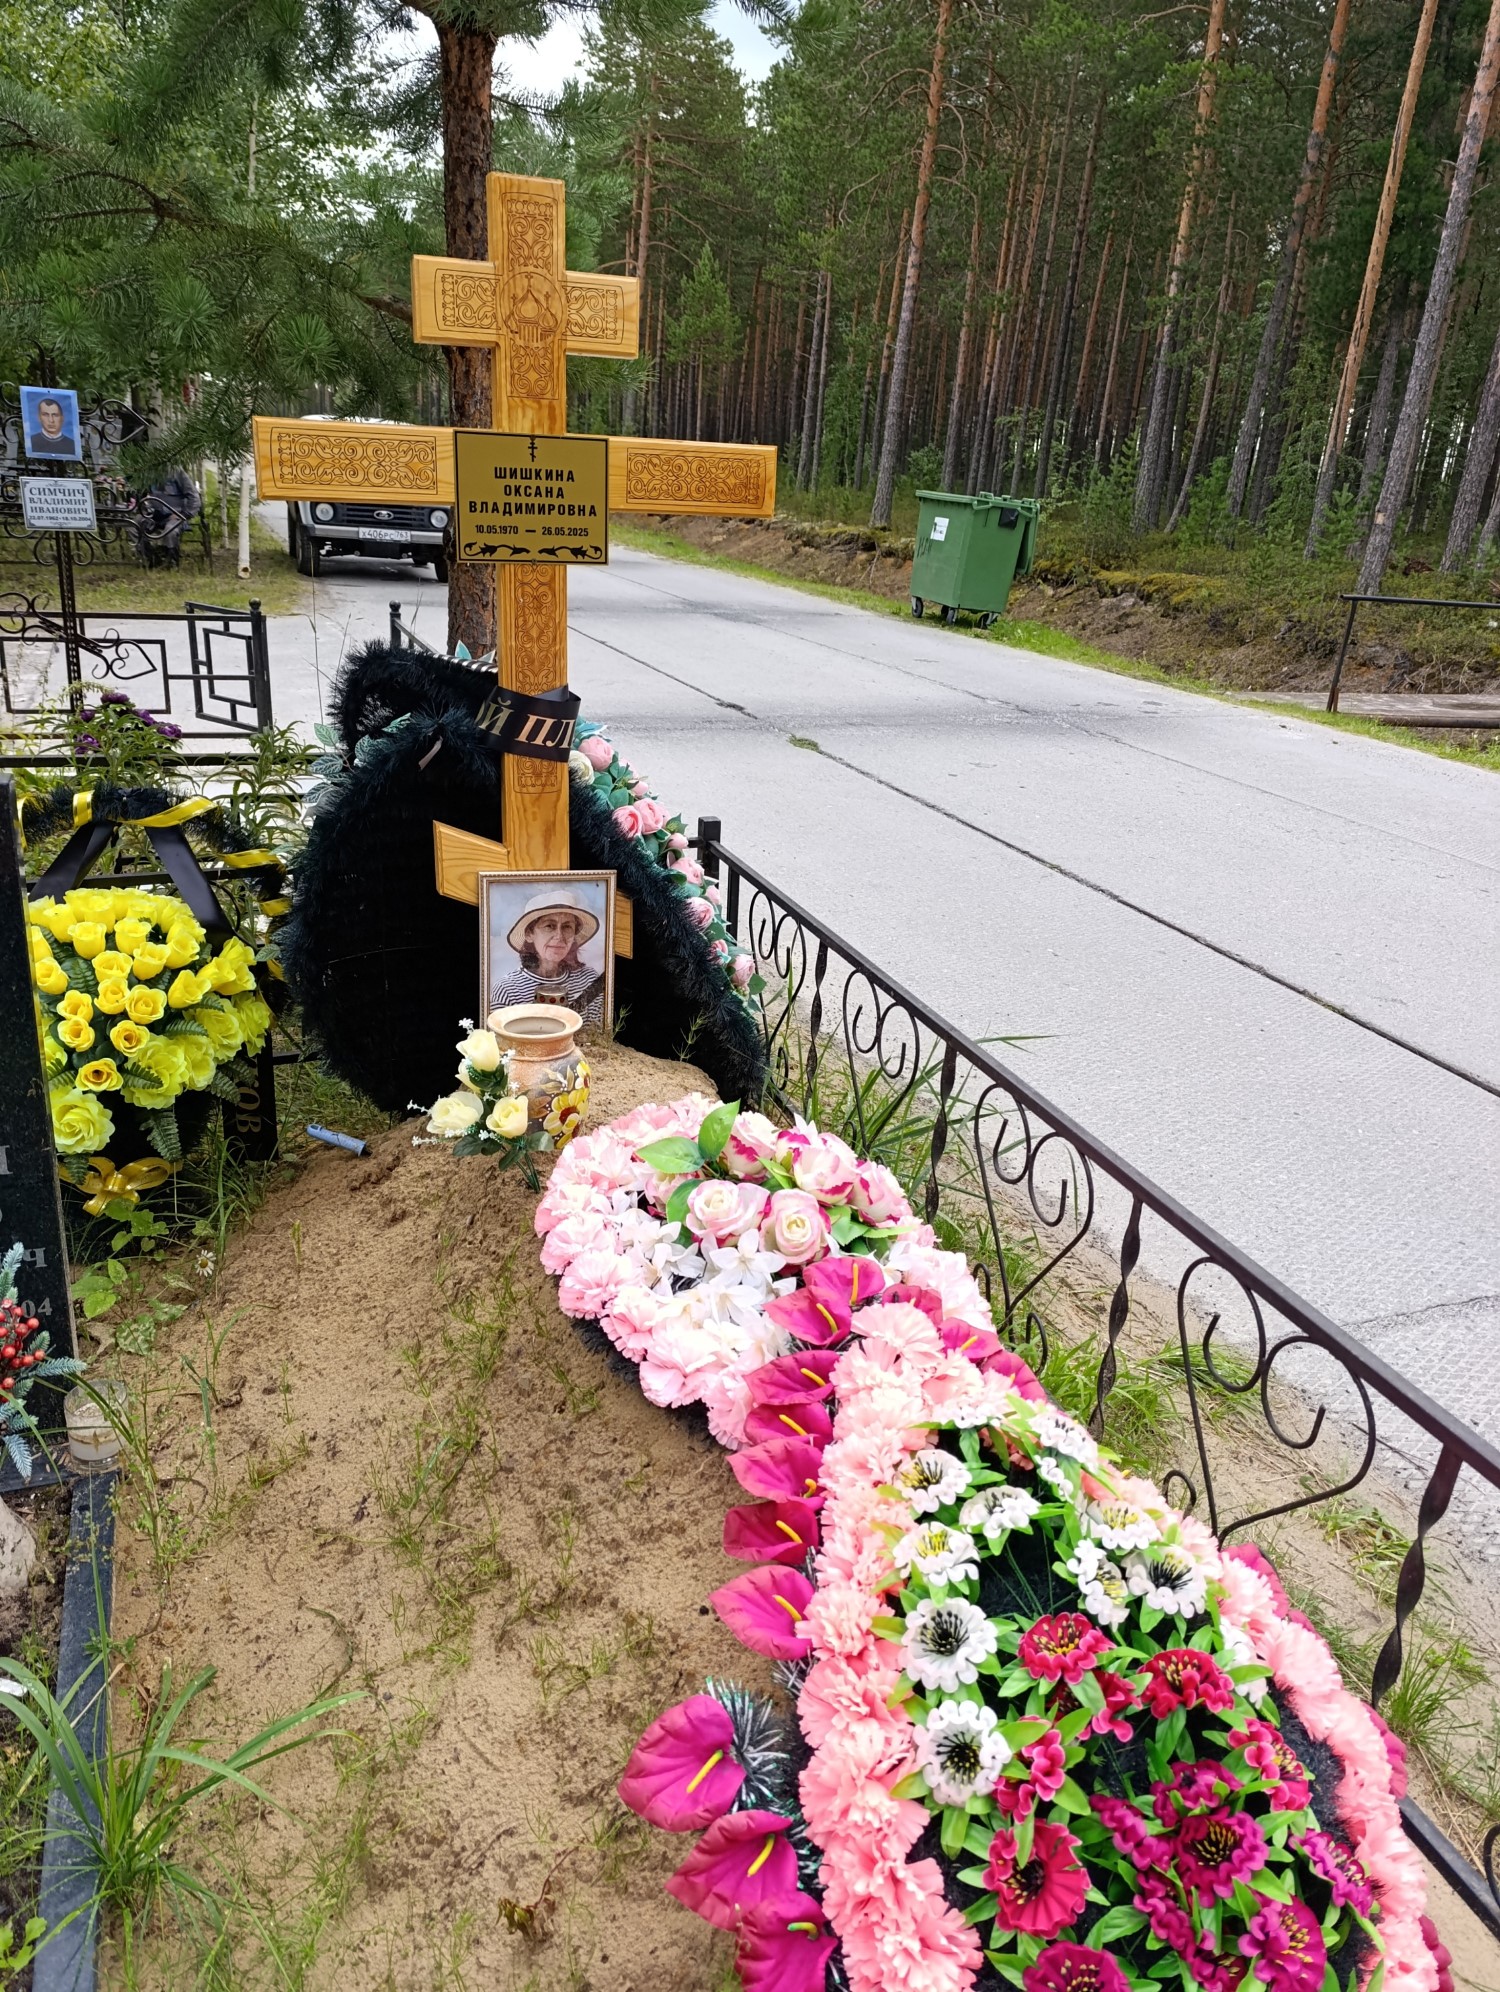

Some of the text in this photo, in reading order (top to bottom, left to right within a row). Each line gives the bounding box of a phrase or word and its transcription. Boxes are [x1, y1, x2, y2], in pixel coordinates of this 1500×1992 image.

[494, 466, 575, 482] ШИШКИНА
[29, 486, 86, 498] СИМЧИЧ
[504, 484, 565, 499] ОКСАНА
[28, 496, 88, 506] ВЛАДИМИР
[30, 506, 89, 515] ИВАНОВИЧ
[468, 500, 597, 517] ВЛАДИМИРОВНА
[475, 524, 519, 535] 10.05.1970
[541, 526, 589, 537] 26.05.2025
